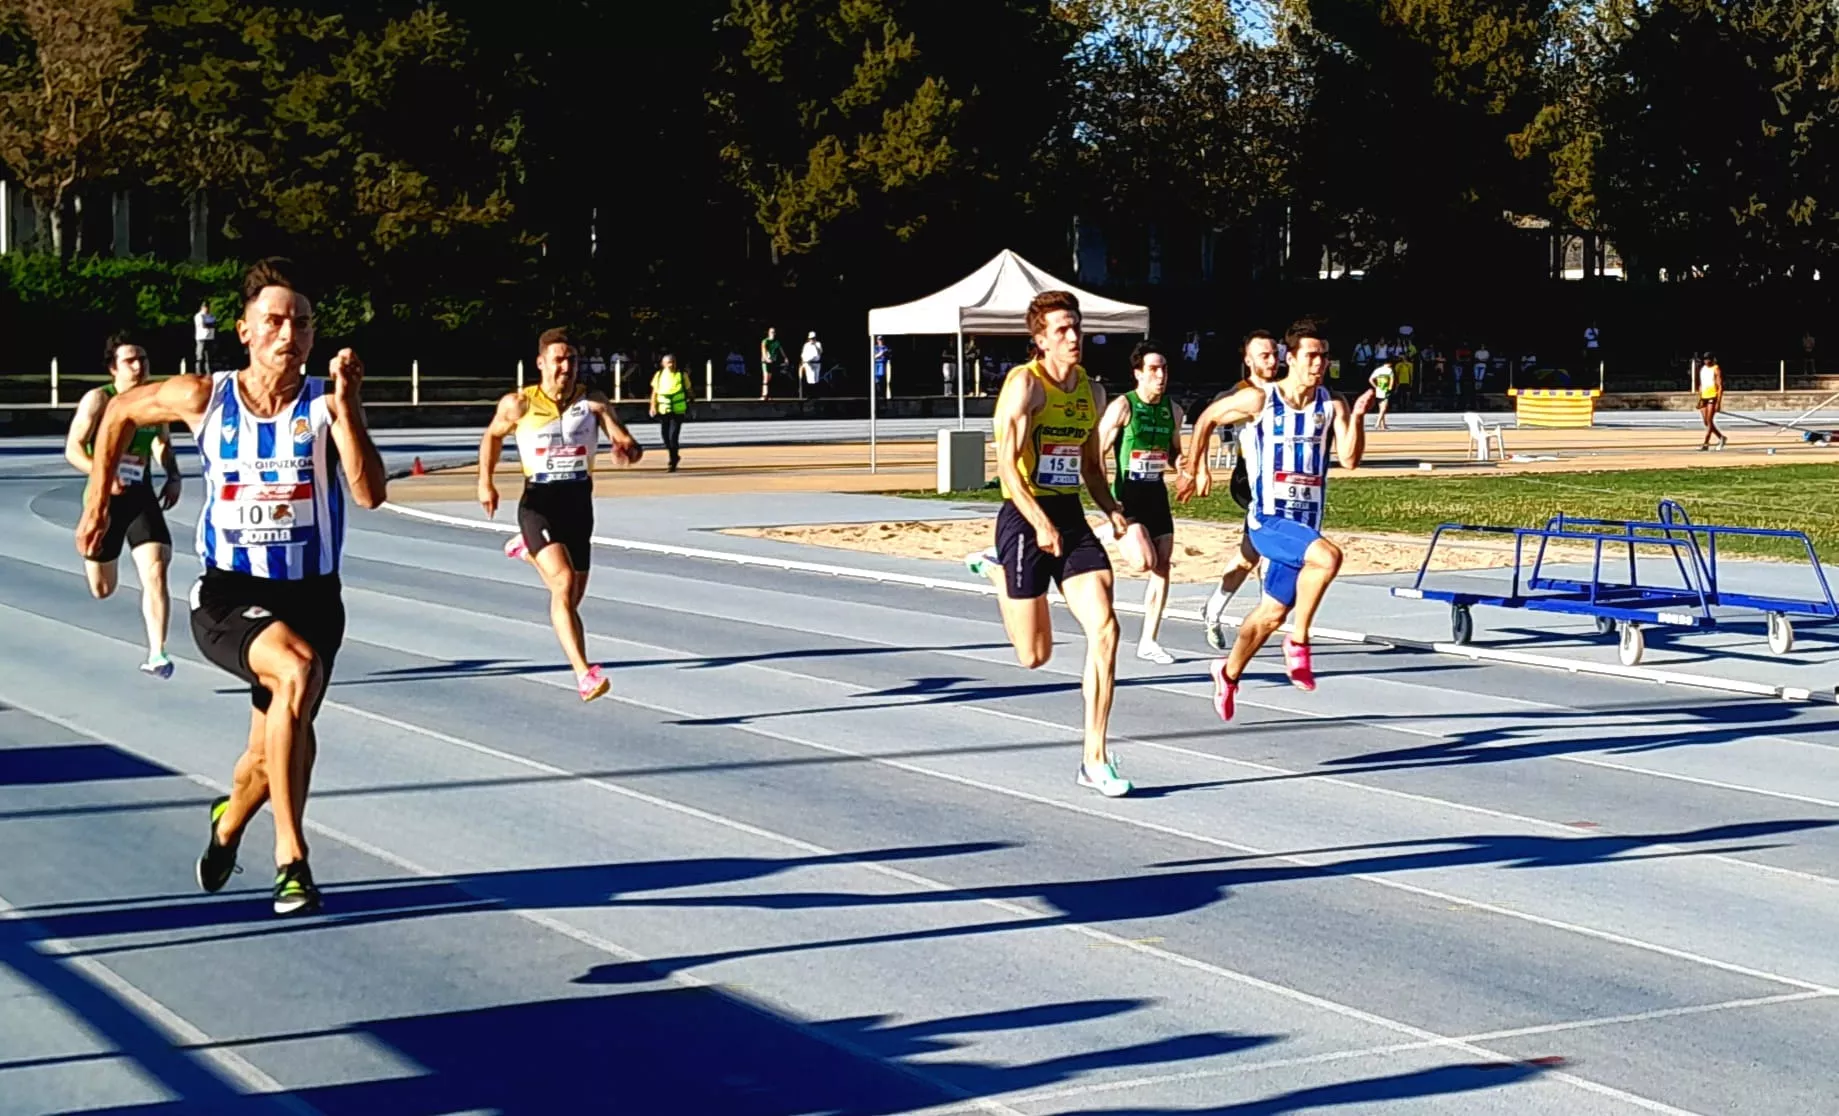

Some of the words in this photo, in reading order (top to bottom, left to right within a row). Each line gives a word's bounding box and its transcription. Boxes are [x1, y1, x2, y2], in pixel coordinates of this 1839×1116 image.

[546, 459, 554, 470] 6
[1050, 458, 1065, 472] 15
[1288, 486, 1297, 498] 9
